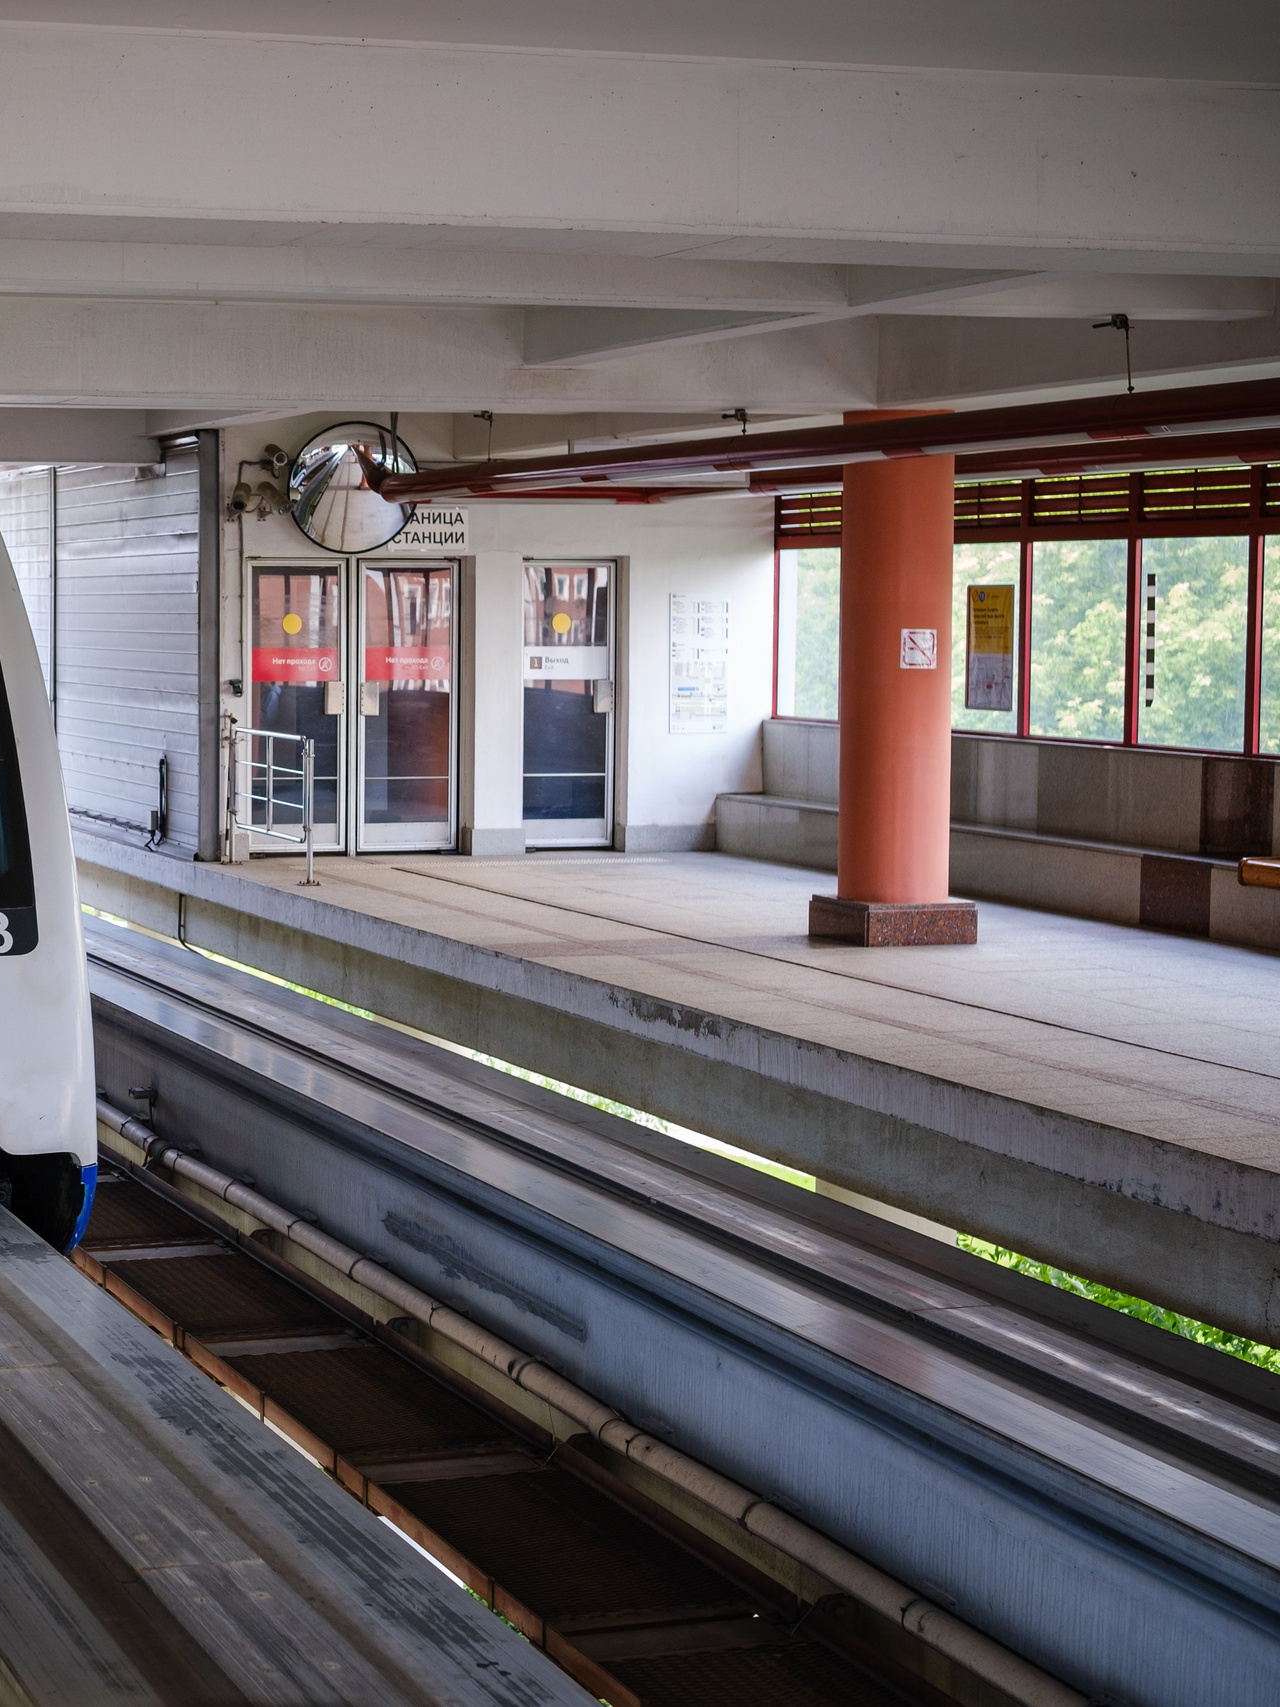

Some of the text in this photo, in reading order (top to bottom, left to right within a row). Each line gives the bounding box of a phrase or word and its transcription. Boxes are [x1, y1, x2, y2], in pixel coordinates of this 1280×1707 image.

[410, 512, 465, 527] АНИЦА
[272, 657, 316, 666] Нет прохода
[385, 656, 429, 666] Нет прохода
[544, 656, 569, 664] Выход
